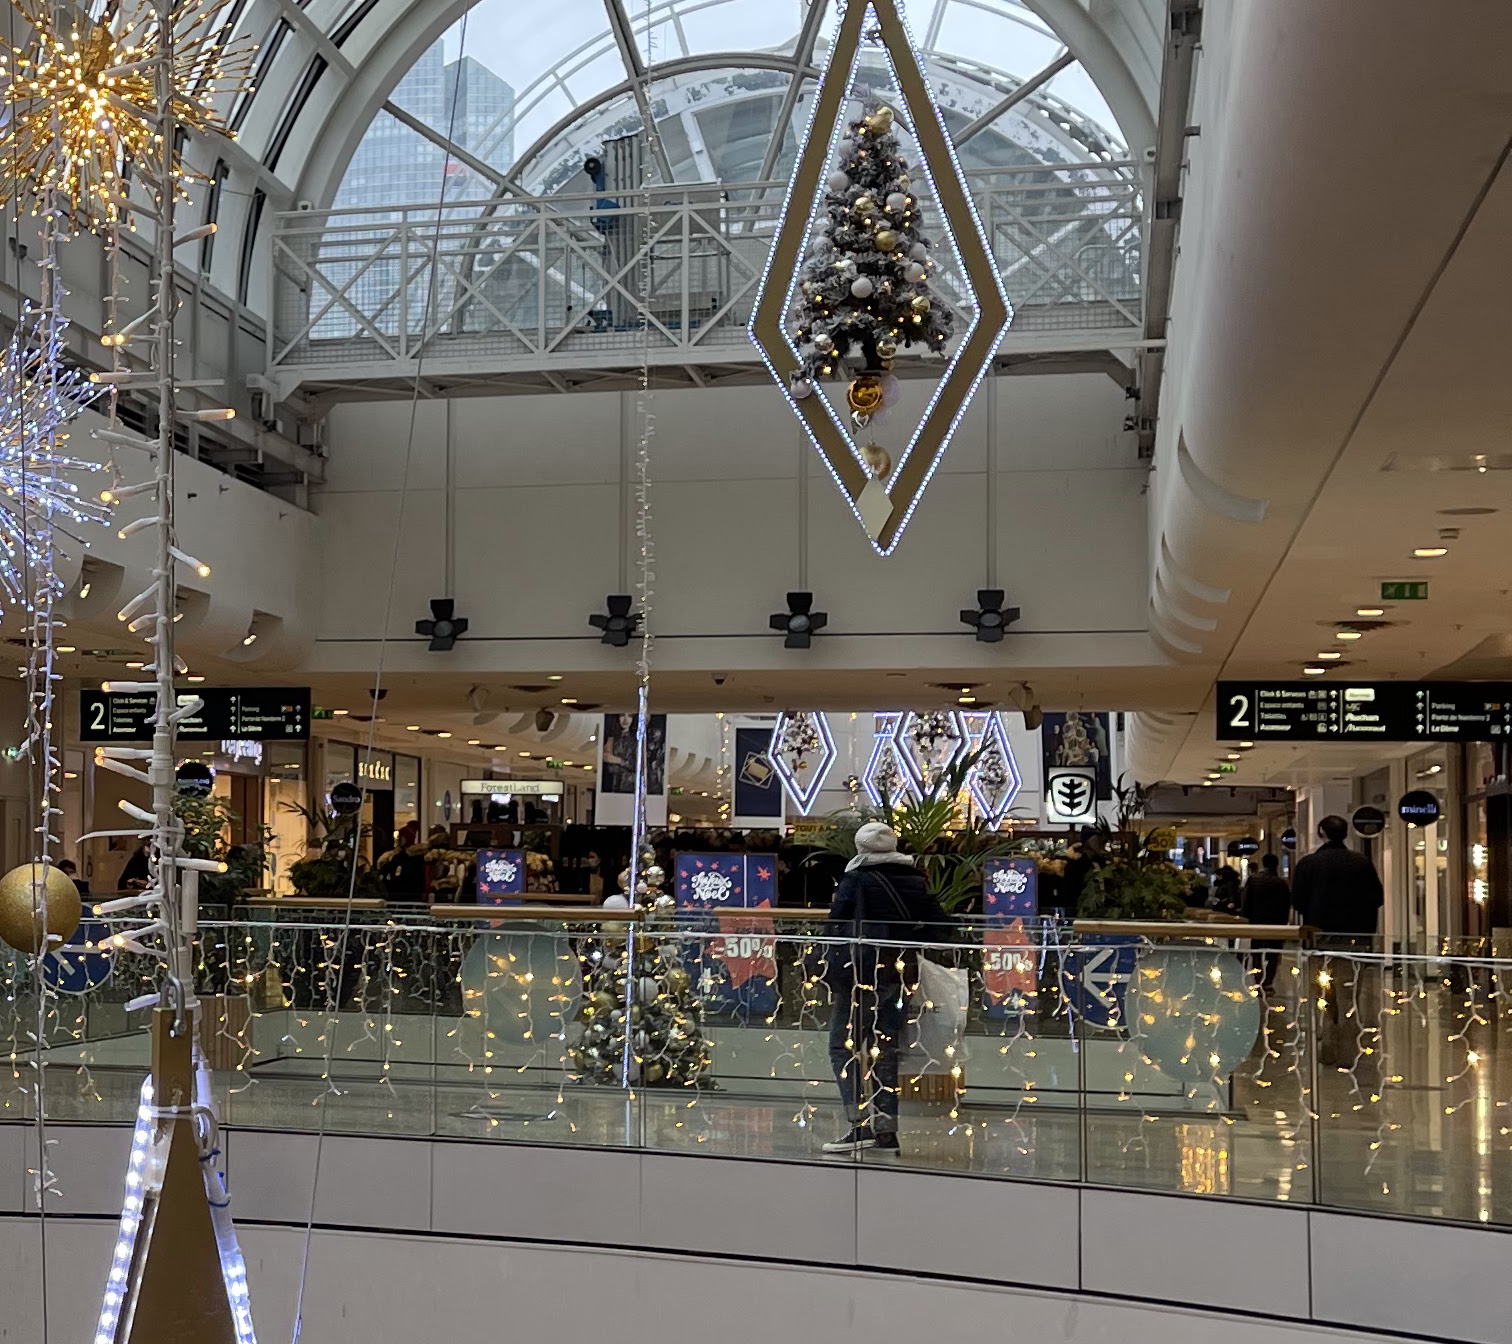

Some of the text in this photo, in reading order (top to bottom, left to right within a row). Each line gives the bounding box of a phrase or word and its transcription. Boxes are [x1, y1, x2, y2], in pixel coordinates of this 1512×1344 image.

[90, 702, 106, 730] 2
[1229, 694, 1250, 727] 2
[1401, 803, 1437, 814] minelli
[691, 871, 732, 889] Joyeux
[715, 937, 773, 958] -50%
